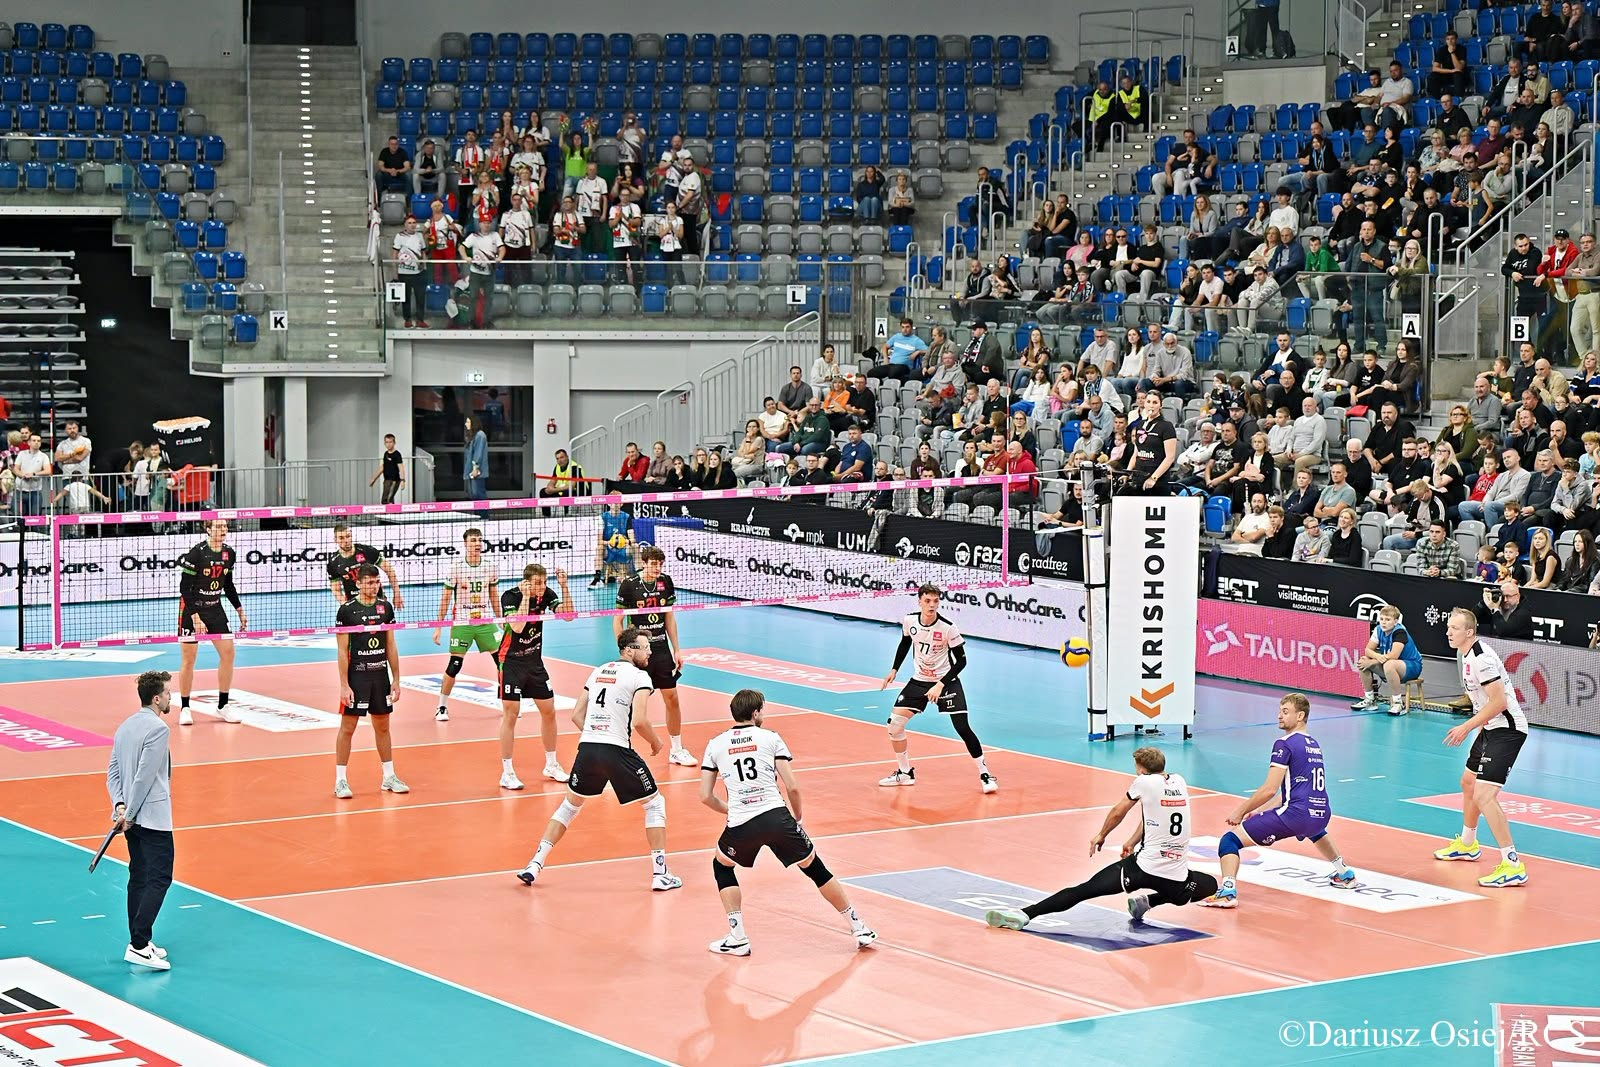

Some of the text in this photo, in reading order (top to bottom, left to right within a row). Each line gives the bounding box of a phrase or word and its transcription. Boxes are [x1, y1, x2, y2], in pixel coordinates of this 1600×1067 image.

[1228, 41, 1236, 53] A
[391, 289, 401, 300] L
[792, 291, 801, 302] L
[274, 317, 285, 328] K
[878, 324, 885, 336] A
[1406, 321, 1416, 335] A
[1515, 324, 1525, 339] B
[805, 530, 825, 546] mpk
[837, 532, 877, 553] LUM
[916, 545, 940, 557] radpec
[1032, 556, 1068, 571] radfrez
[211, 566, 223, 578] 17
[470, 582, 482, 592] 16
[824, 569, 893, 591] OrthoCare
[1141, 506, 1166, 679] KRISHOME
[1278, 590, 1329, 606] visitRadom.pl
[986, 592, 1066, 620] OrthoCare.
[451, 638, 459, 646] 16
[919, 642, 931, 655] 77
[1244, 633, 1360, 673] TAURON
[505, 685, 511, 694] 8
[596, 688, 606, 708] 4
[733, 757, 758, 782] 13
[1311, 768, 1325, 791] 16
[1170, 812, 1183, 836] 8
